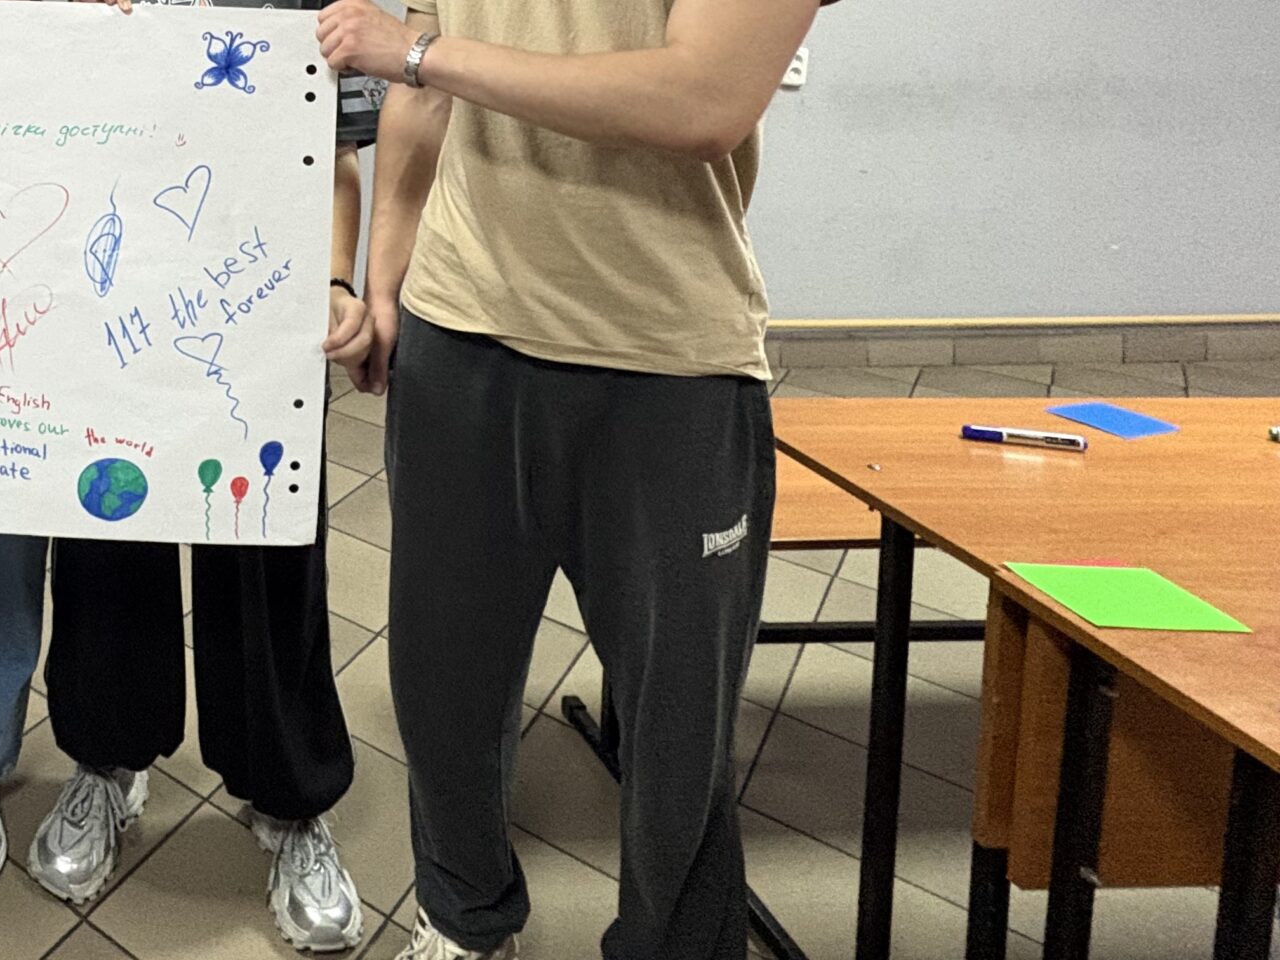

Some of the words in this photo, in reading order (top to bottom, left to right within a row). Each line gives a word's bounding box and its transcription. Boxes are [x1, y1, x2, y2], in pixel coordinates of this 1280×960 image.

[105, 306, 152, 368] 117
[169, 287, 208, 329] the
[204, 226, 267, 288] best
[220, 258, 292, 325] forever
[38, 422, 69, 435] our
[85, 427, 106, 447] the
[115, 437, 154, 458] world
